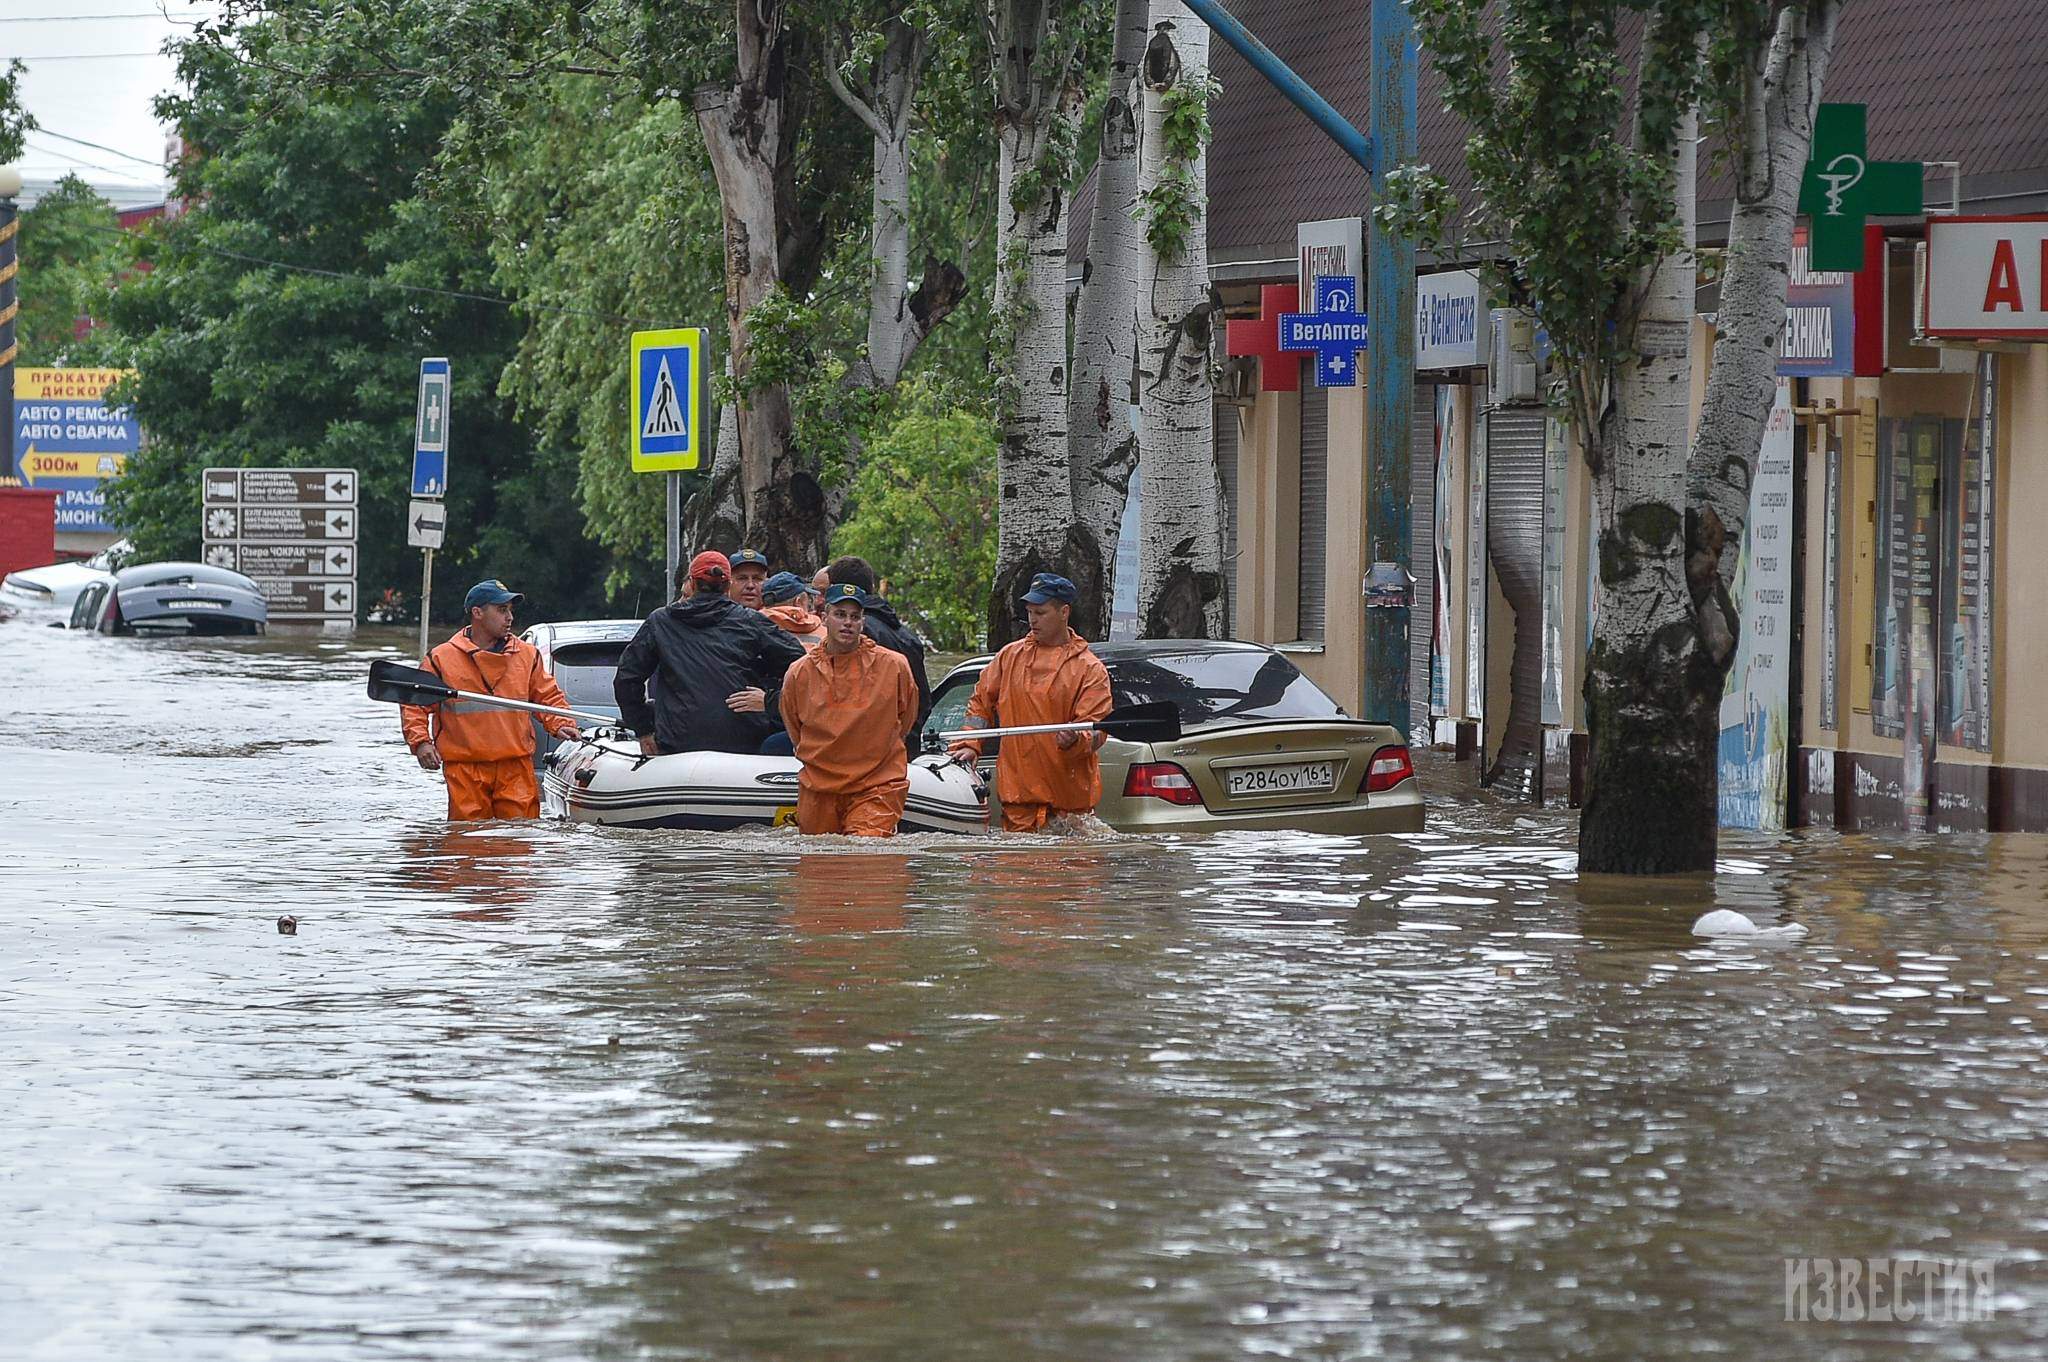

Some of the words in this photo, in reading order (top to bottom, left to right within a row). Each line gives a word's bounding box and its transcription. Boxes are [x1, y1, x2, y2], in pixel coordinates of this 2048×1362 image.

[1431, 293, 1475, 346] ВетАптека
[31, 372, 118, 384] ПРОКАТКА
[20, 406, 61, 421] АВТО
[20, 425, 62, 439] АВТО
[66, 425, 128, 440] СВАРКА
[32, 457, 78, 471] 300м
[241, 546, 269, 558] Озеро
[269, 546, 307, 557] ЧОКРАК
[1303, 765, 1328, 780] 161
